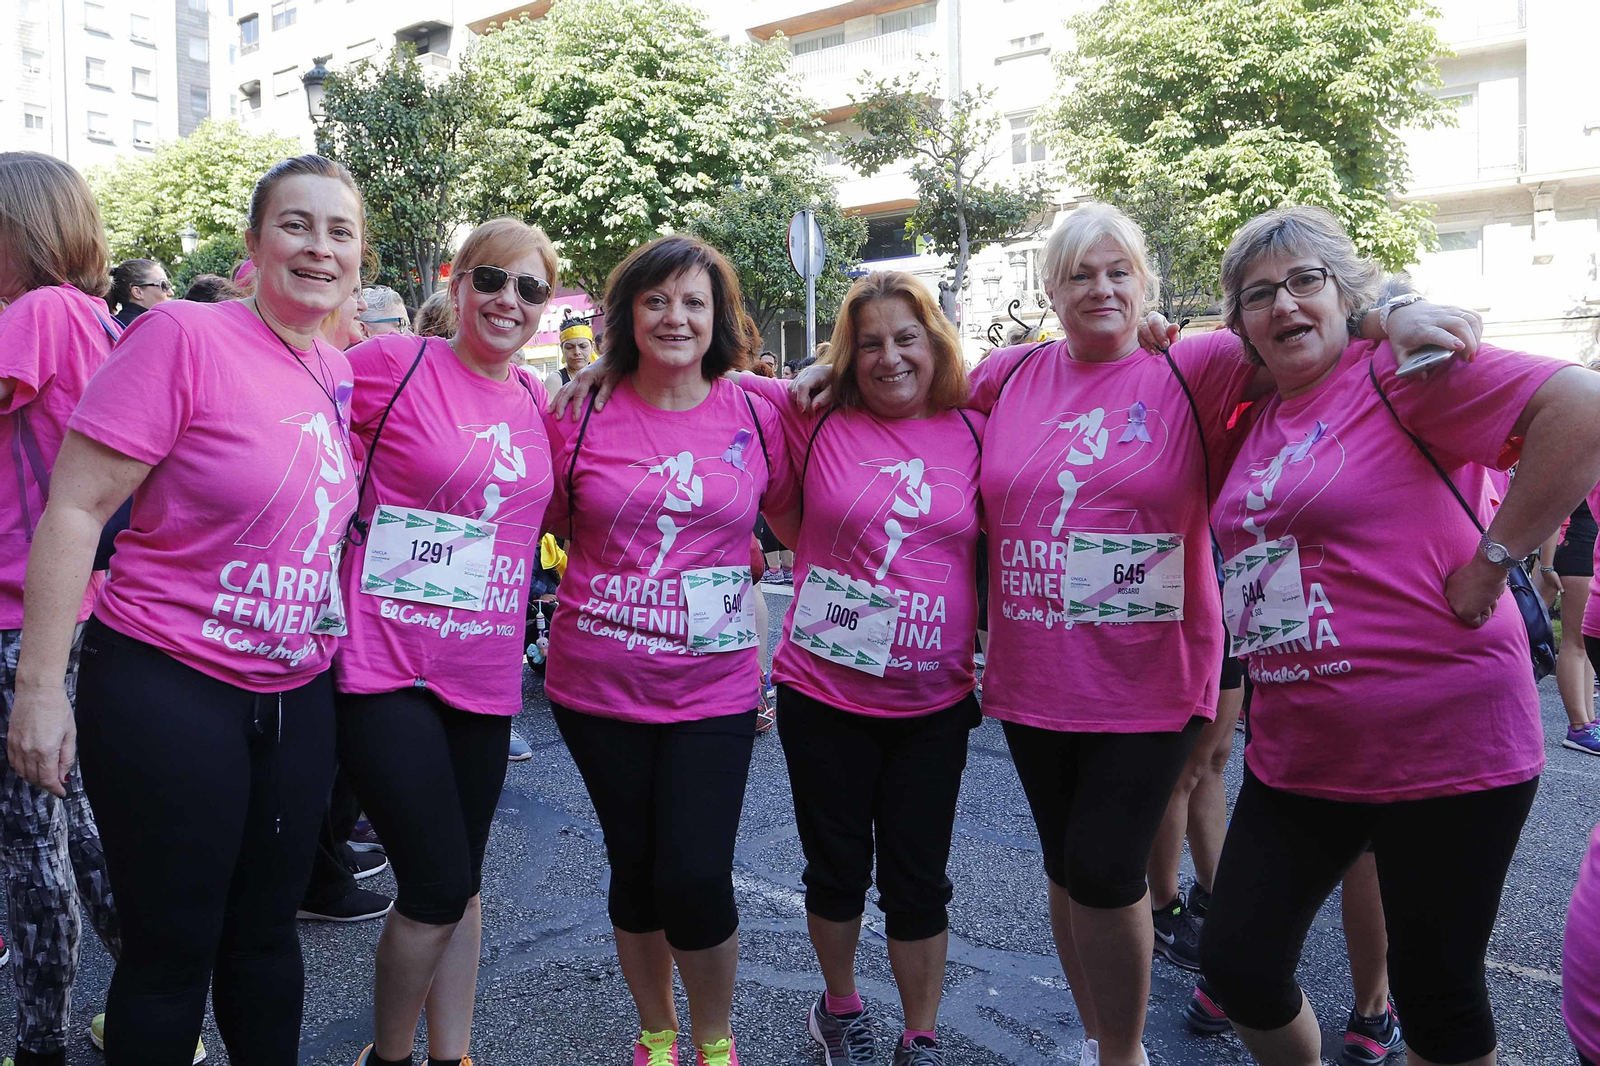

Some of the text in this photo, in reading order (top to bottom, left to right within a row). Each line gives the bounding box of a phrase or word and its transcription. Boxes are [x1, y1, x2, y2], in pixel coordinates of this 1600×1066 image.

[410, 539, 453, 566] 1291
[1113, 563, 1146, 585] 645
[1117, 587, 1140, 595] ROSARIO
[1241, 579, 1266, 607] 644
[723, 593, 742, 615] 640
[380, 600, 516, 640] El Corte Inglés VIGO
[825, 601, 860, 631] 1006
[590, 619, 627, 642] Corte
[917, 661, 940, 672] VIGO
[1314, 660, 1352, 676] VIGO
